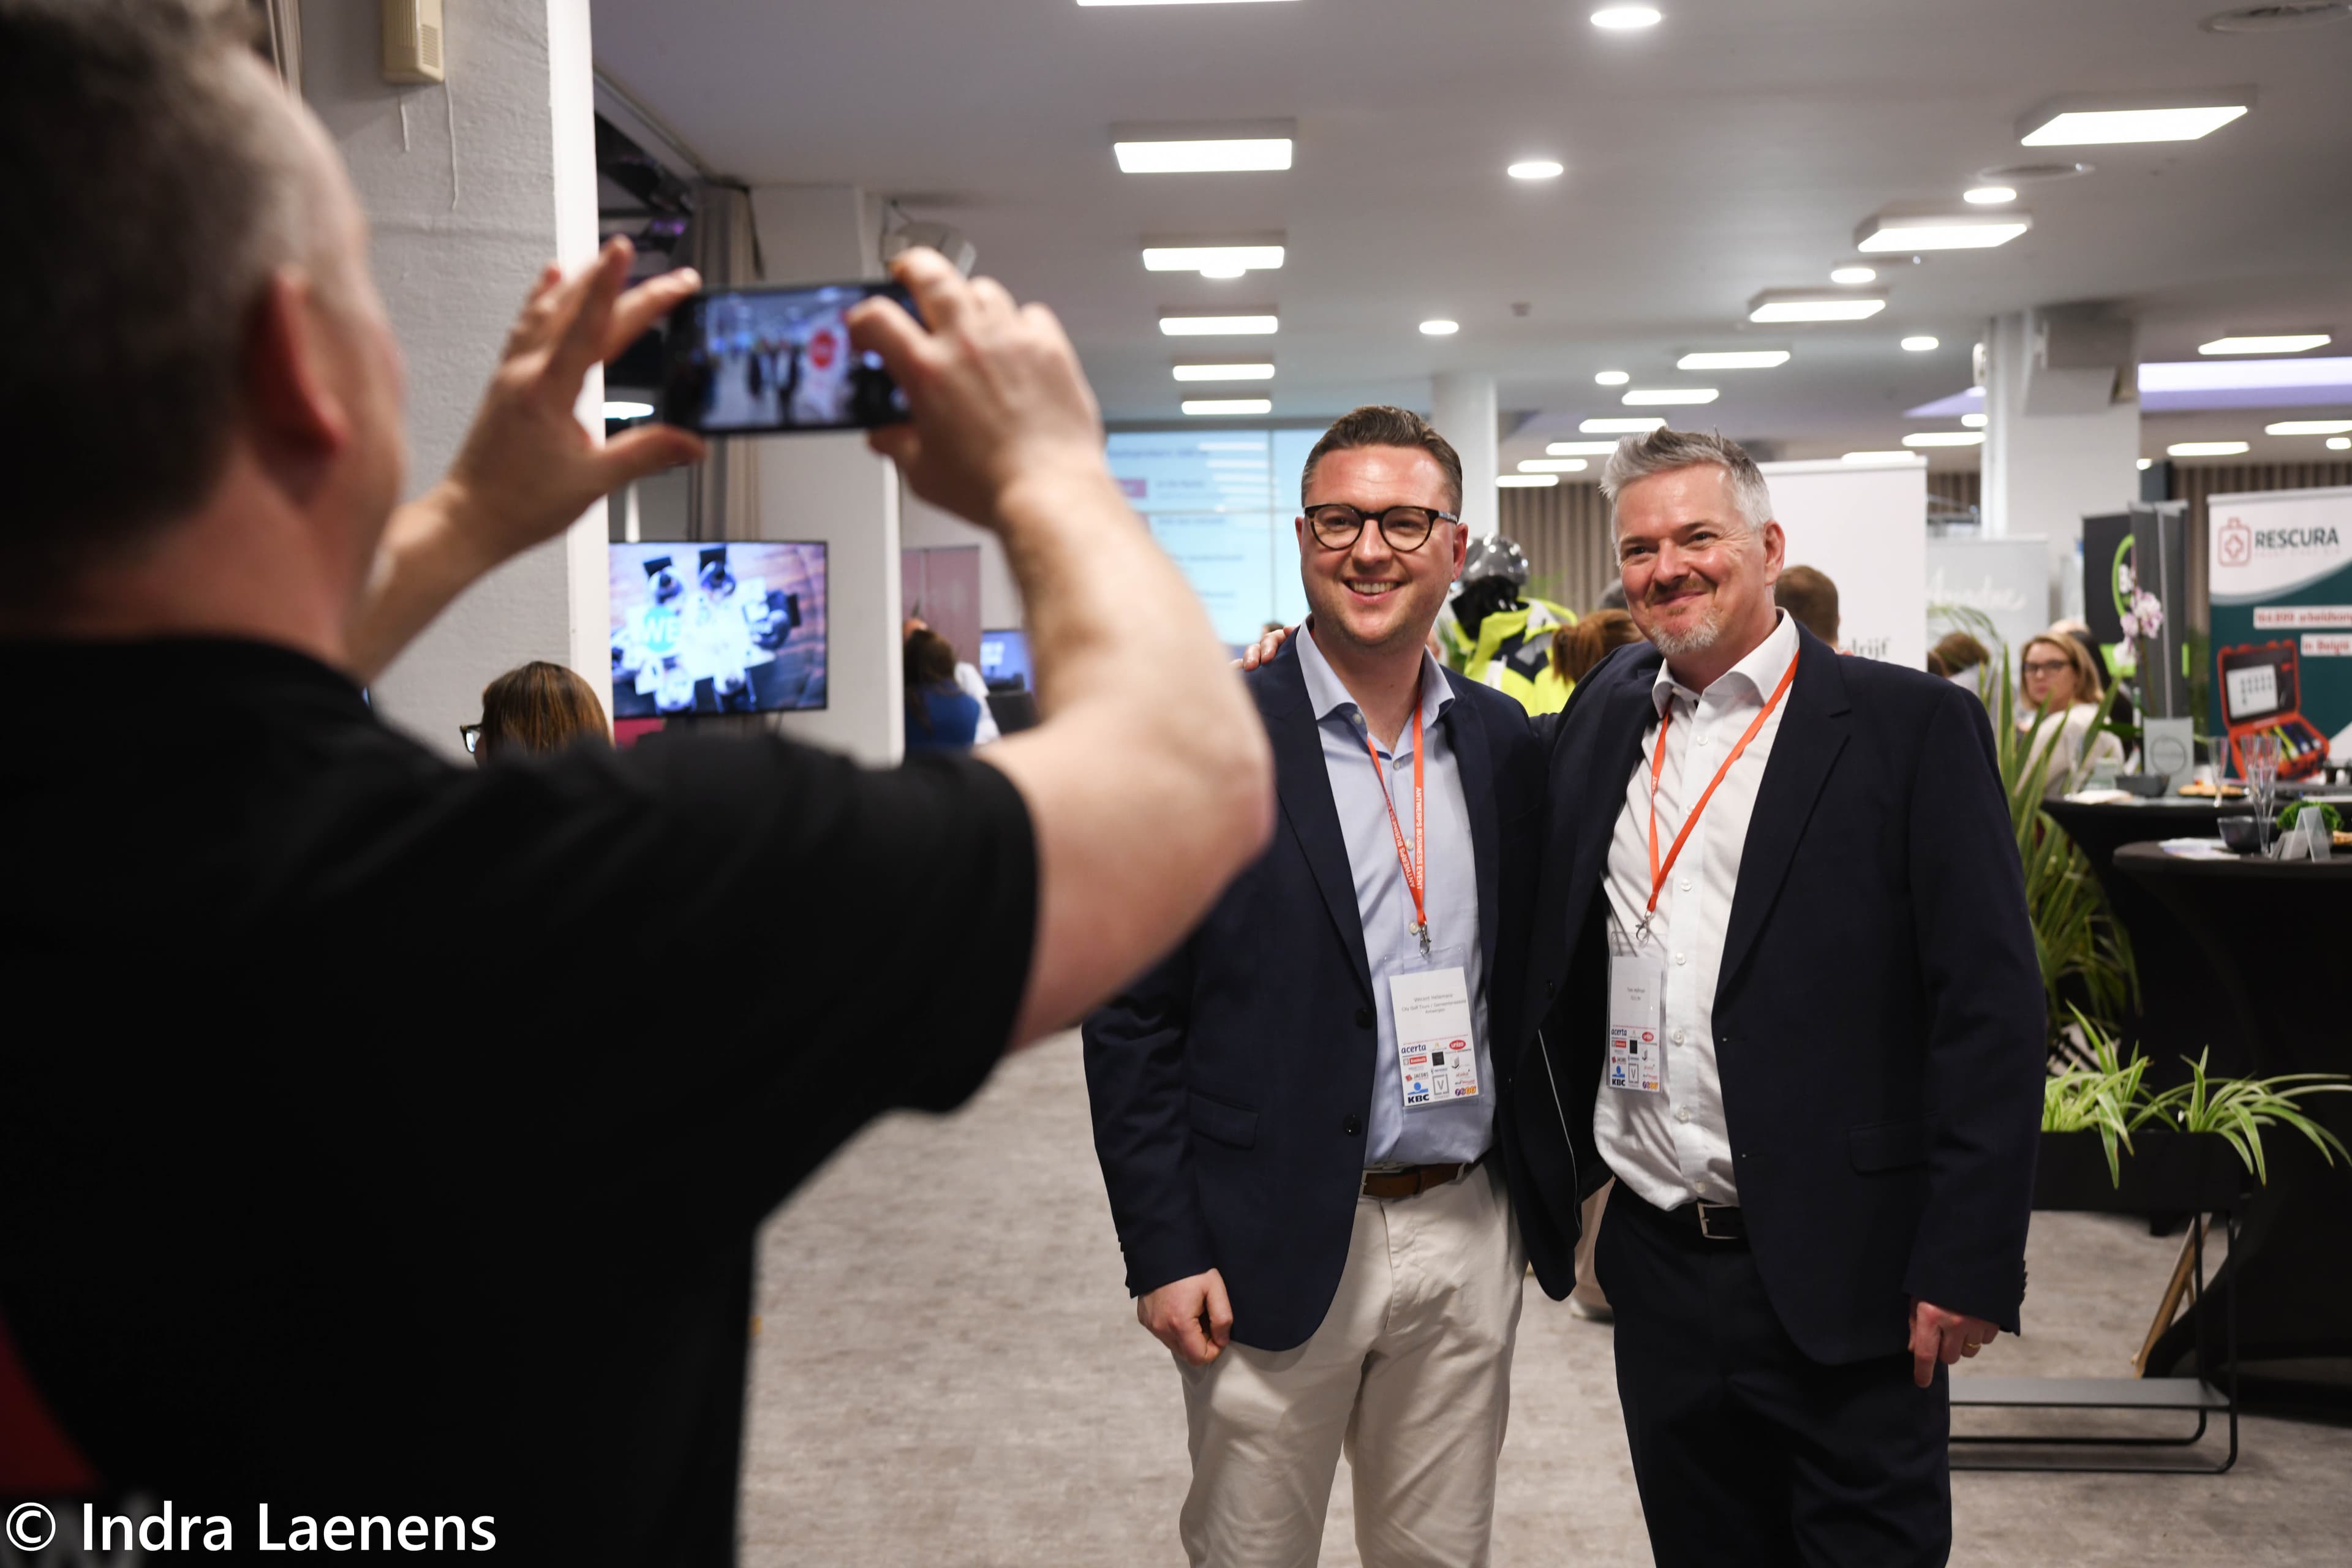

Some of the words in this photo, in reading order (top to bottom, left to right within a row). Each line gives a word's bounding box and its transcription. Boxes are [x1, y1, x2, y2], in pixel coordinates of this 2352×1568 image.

[2255, 527, 2339, 548] RESCURA
[1401, 1044, 1427, 1054] acerta
[1408, 1094, 1430, 1103] KBC
